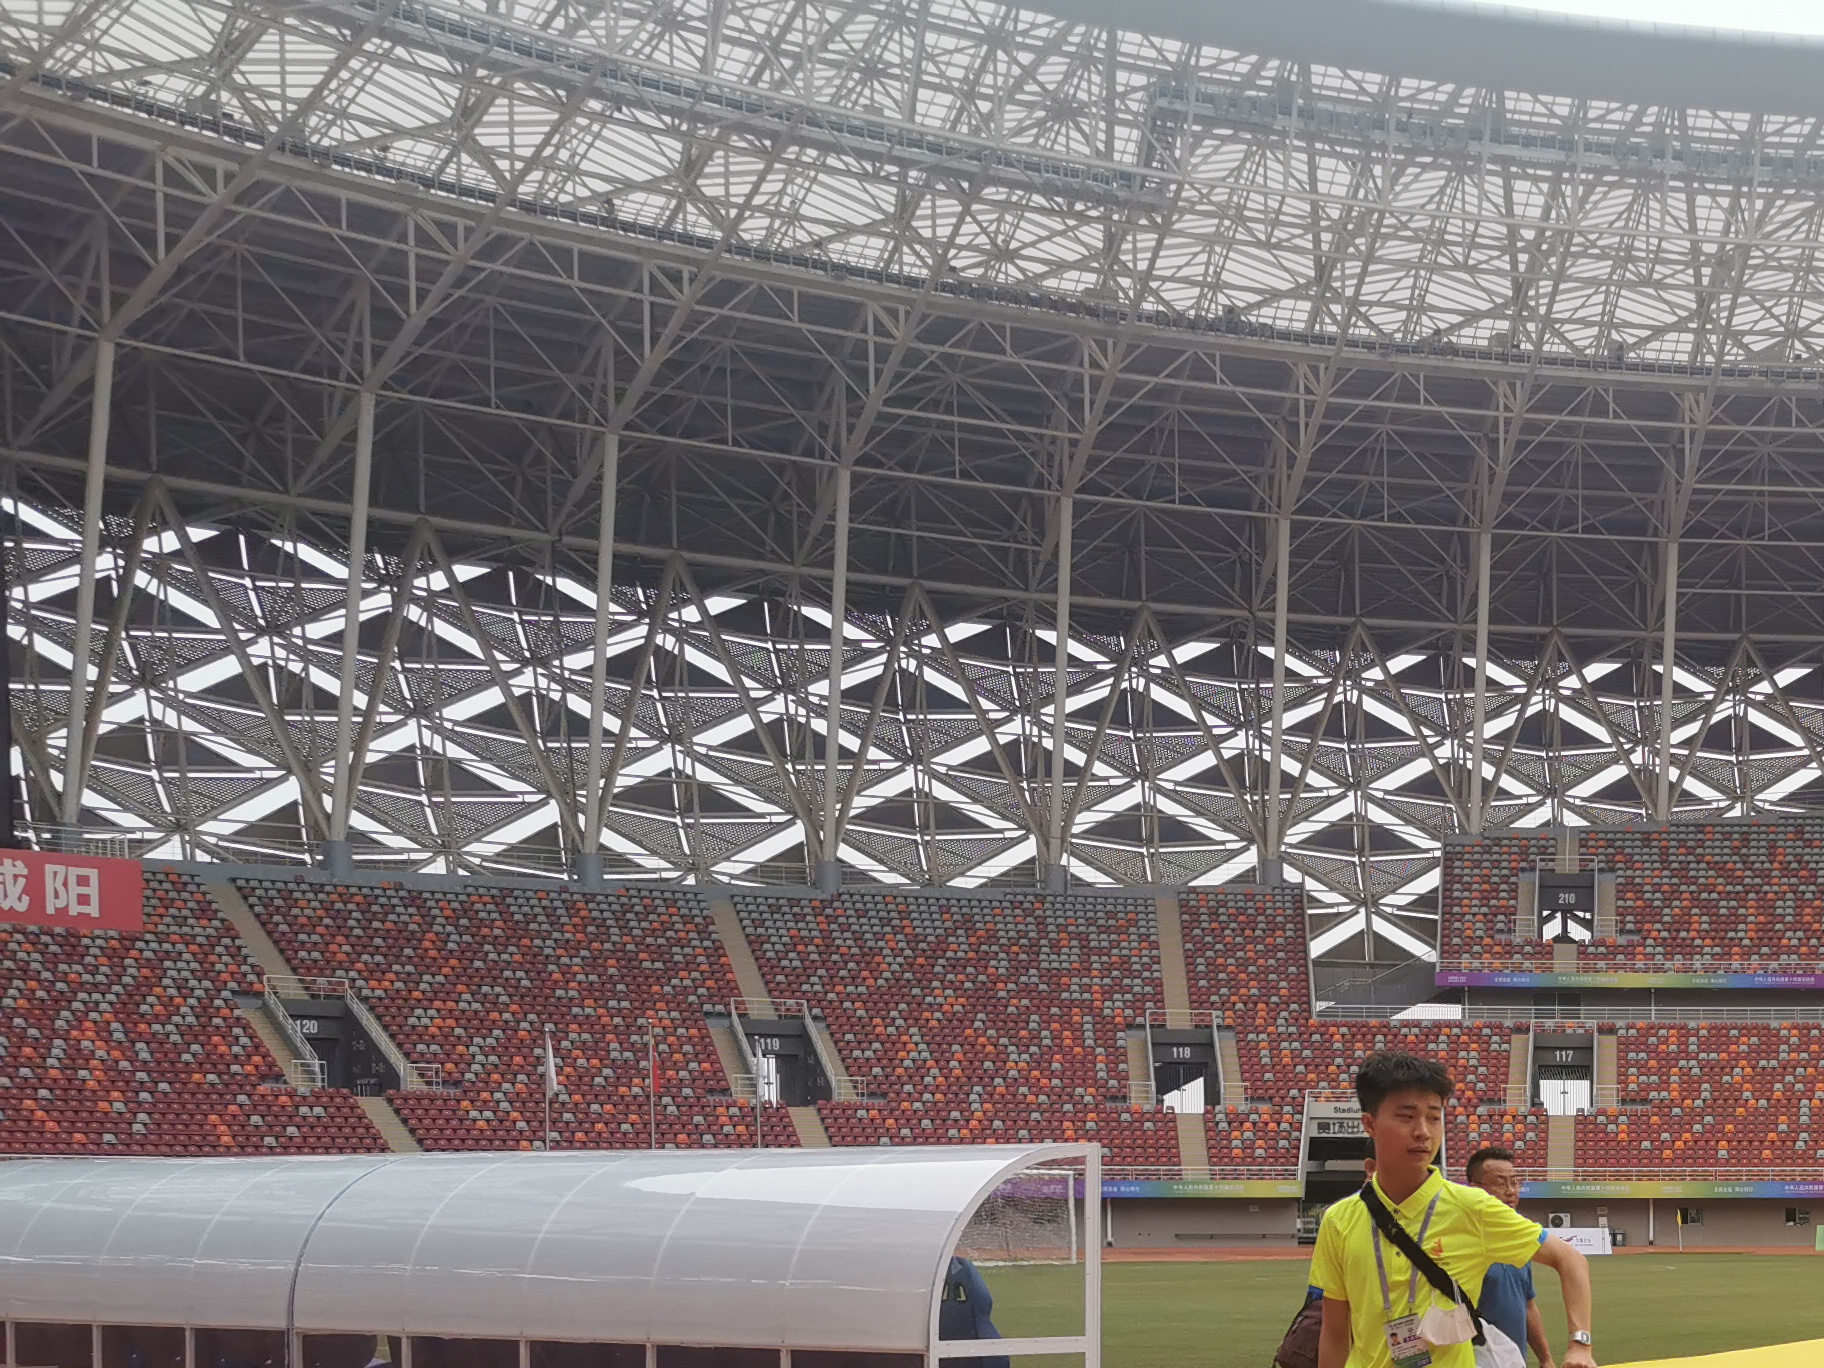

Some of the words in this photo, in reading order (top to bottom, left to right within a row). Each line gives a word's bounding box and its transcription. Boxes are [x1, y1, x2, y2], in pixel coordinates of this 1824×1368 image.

[1558, 893, 1576, 904] 210
[295, 1020, 318, 1034] 120
[760, 1037, 780, 1051] 119
[1172, 1046, 1191, 1058] 118
[1554, 1050, 1574, 1062] 117
